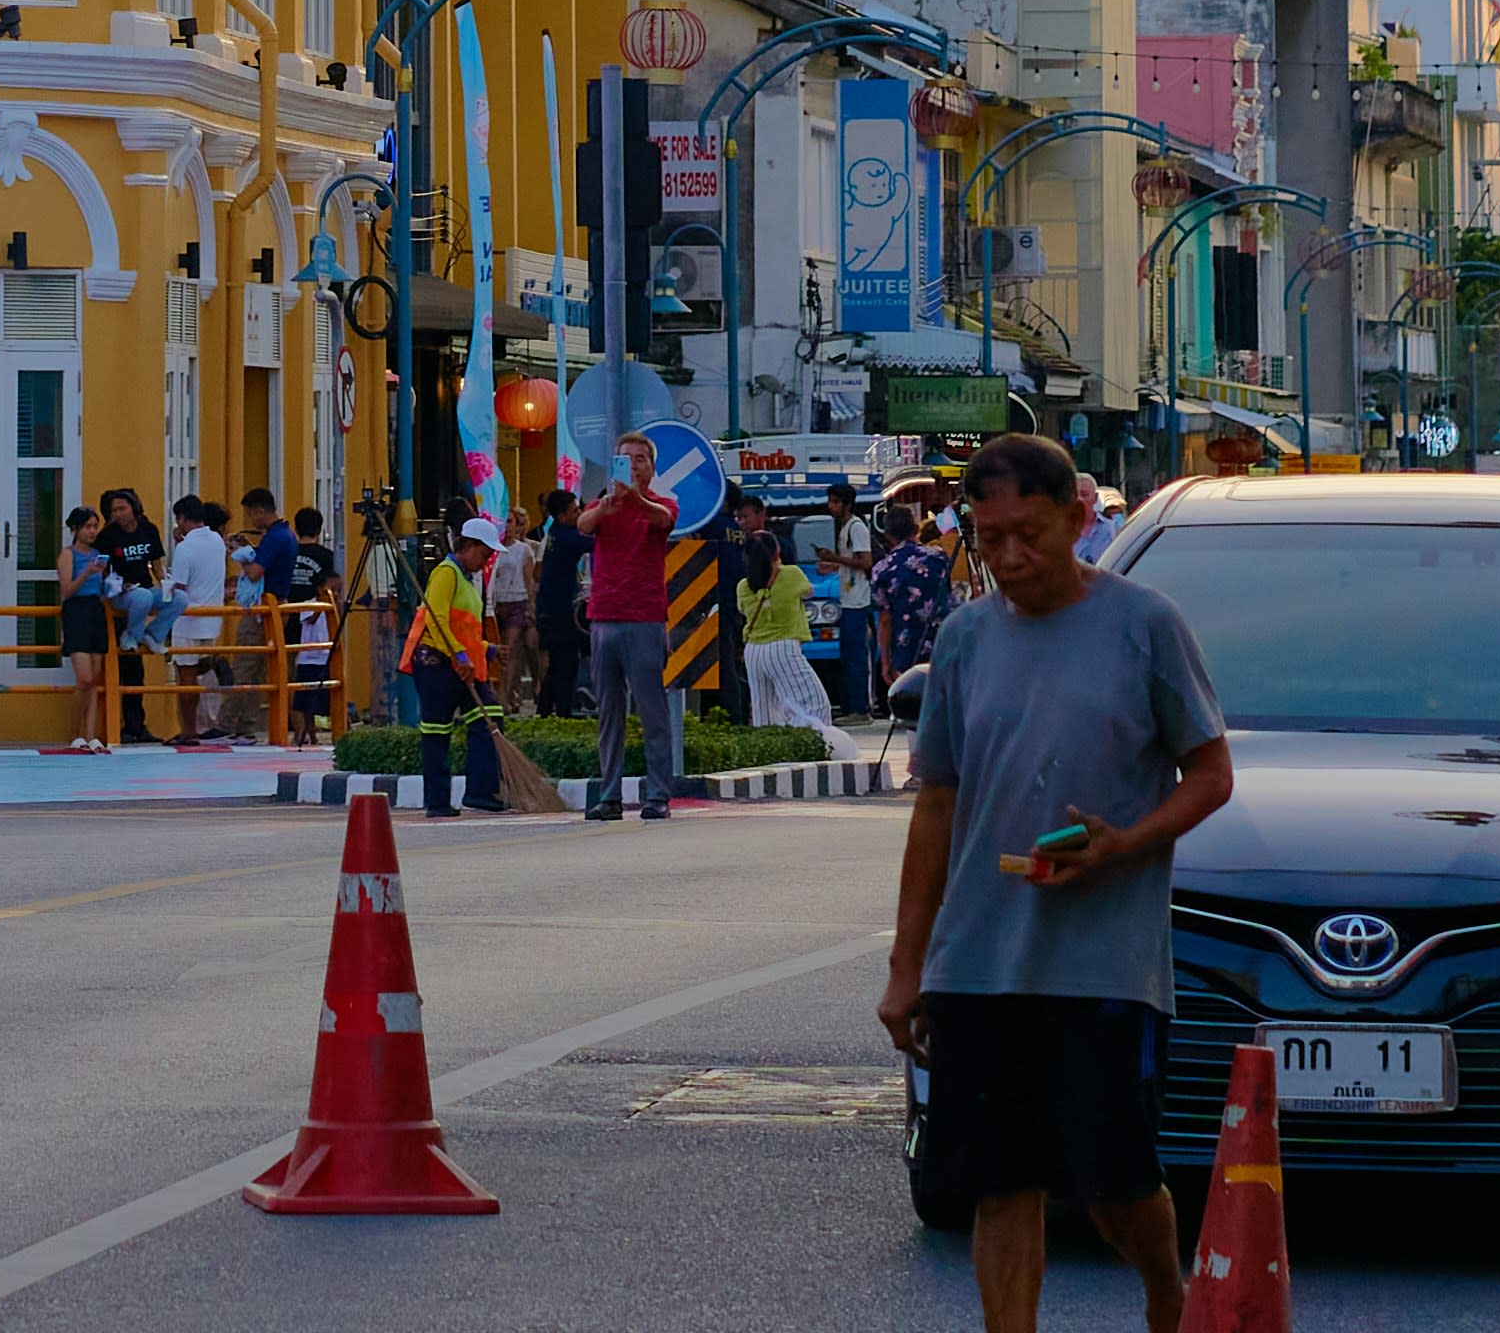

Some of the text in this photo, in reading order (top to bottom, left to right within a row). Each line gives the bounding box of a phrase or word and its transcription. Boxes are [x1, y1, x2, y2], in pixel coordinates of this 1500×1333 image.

[672, 137, 690, 161] FOR
[839, 278, 911, 294] JUITEE
[1283, 1037, 1412, 1073] กก 11
[1333, 1080, 1375, 1098] ภเก็ต
[1292, 1098, 1435, 1112] FRIENDSHIP LEASING
